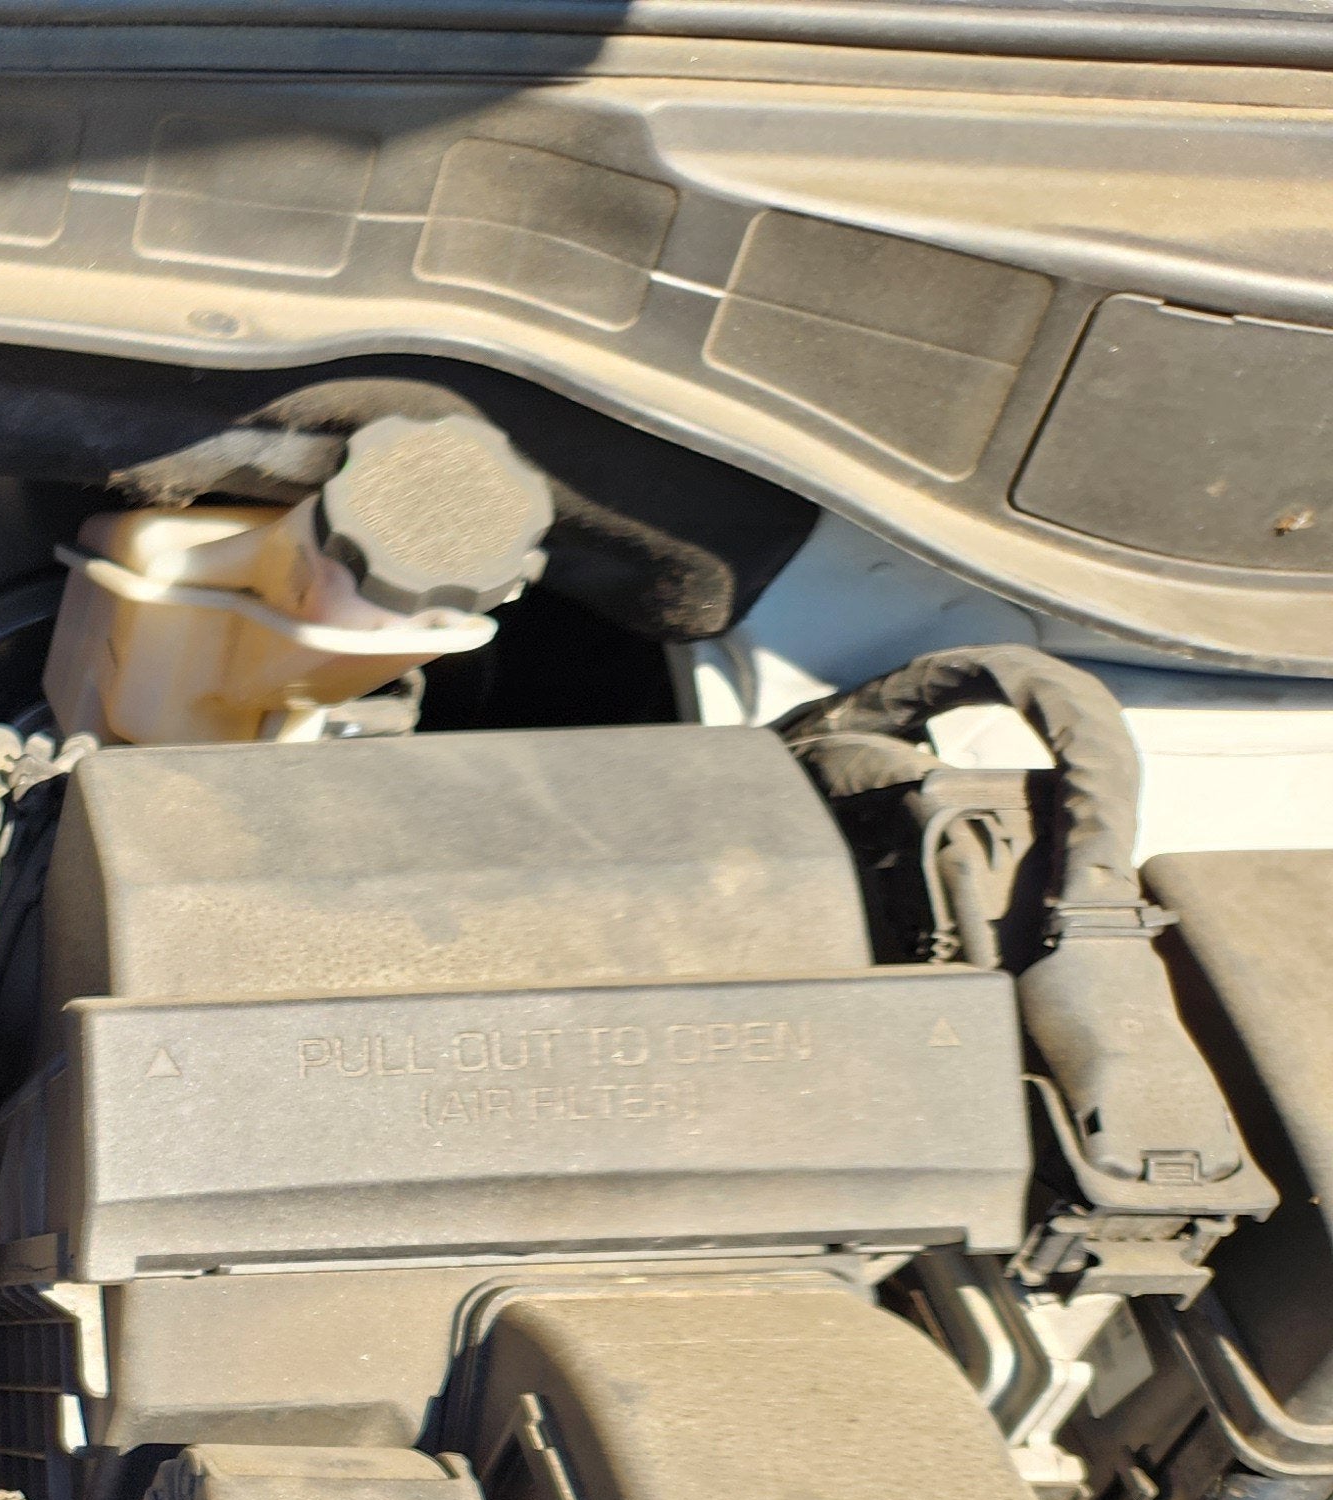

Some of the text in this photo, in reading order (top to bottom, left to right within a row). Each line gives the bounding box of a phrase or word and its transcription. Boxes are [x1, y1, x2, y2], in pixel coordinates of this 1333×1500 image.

[296, 1019, 813, 1079] PULL OUT TO OPEN
[417, 1080, 697, 1128] (AIR FILTER)
